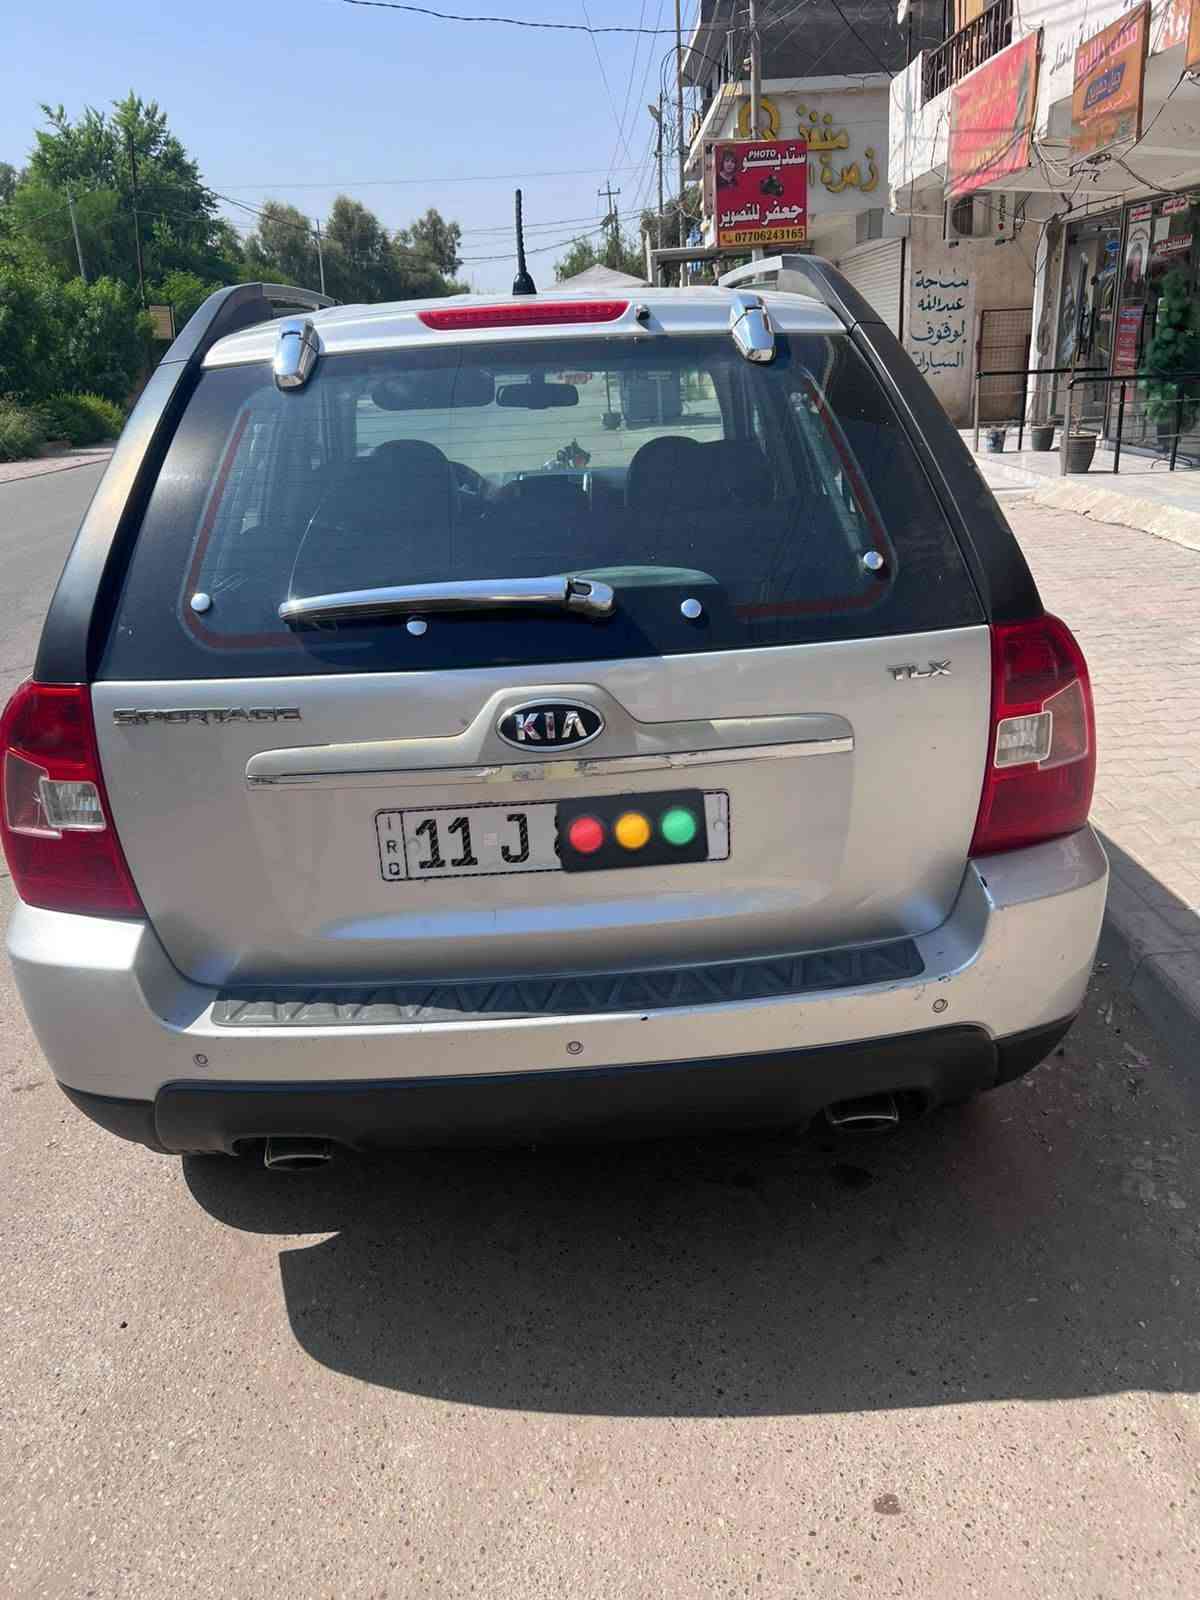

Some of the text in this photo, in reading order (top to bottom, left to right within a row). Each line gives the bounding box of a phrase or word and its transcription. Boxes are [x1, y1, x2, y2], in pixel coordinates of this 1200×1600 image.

[748, 149, 777, 160] PHOTO
[761, 199, 804, 226] جعفر
[735, 227, 804, 244] 07706243165
[886, 659, 952, 680] TLX
[113, 707, 302, 726] SPORTAGE
[512, 710, 588, 741] KIA
[415, 816, 479, 869] 11
[500, 813, 530, 864] J
